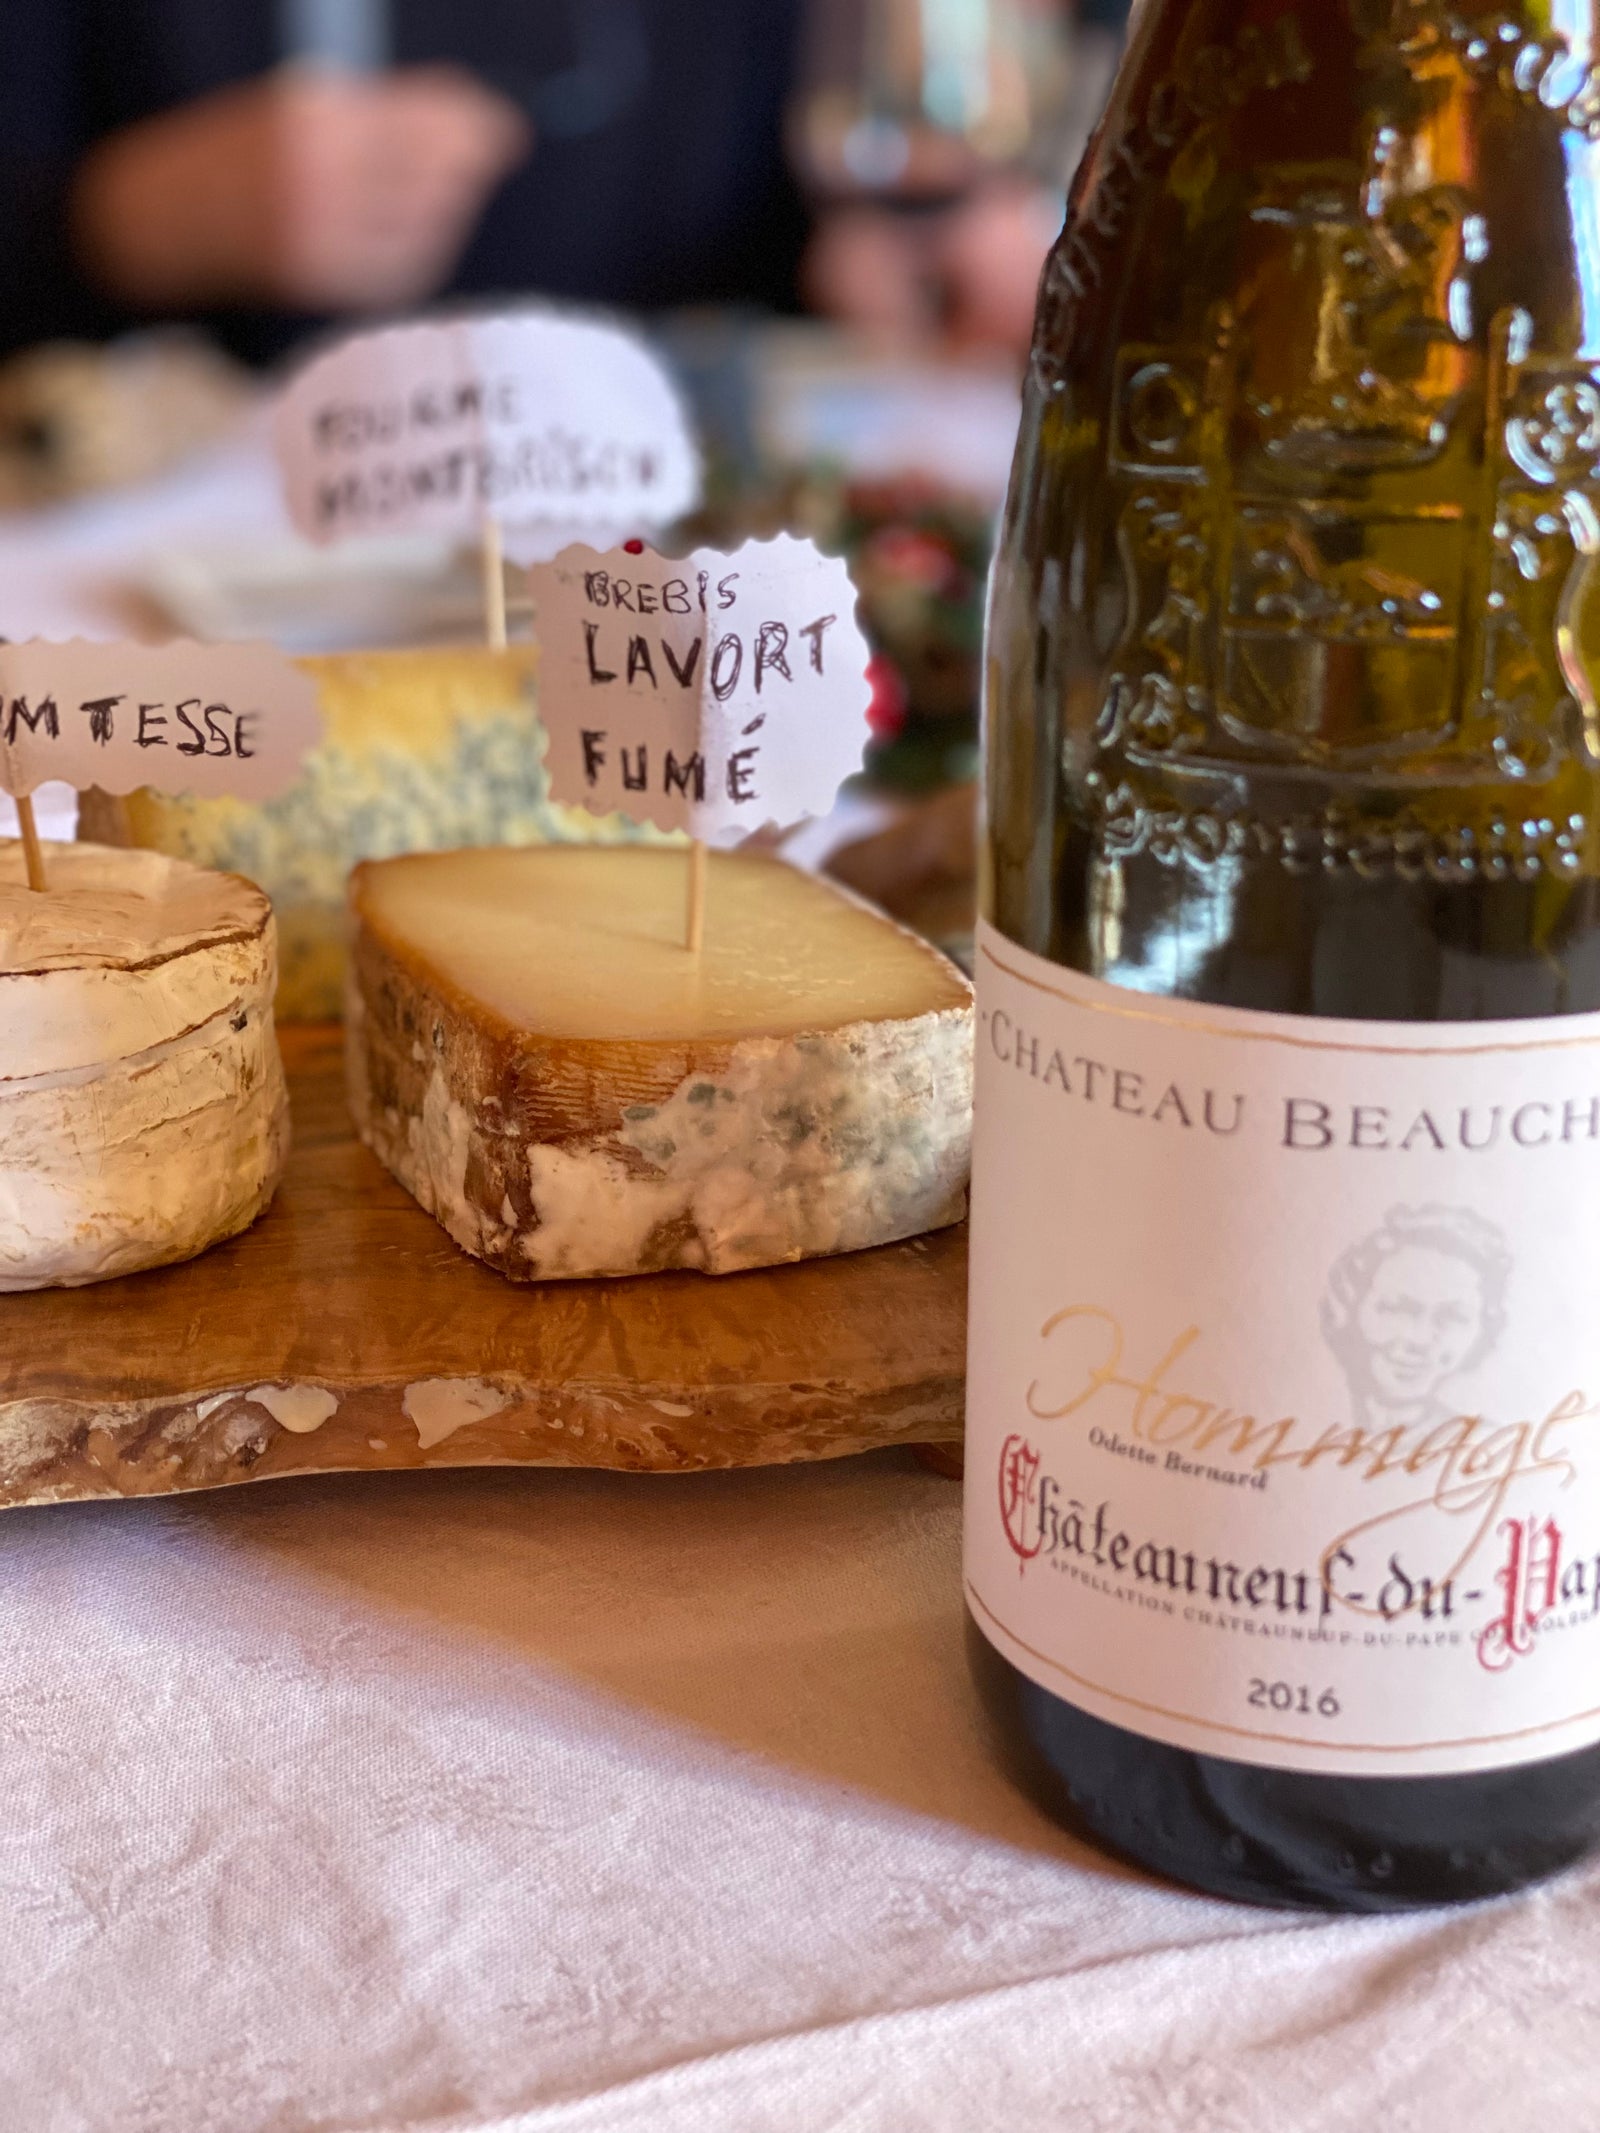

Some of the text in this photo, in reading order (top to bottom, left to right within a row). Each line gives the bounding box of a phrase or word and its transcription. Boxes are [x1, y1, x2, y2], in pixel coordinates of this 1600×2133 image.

[585, 570, 740, 614] BREBIS
[583, 614, 836, 701] LAVORT
[0, 695, 258, 758] MTESSE
[580, 713, 766, 804] FUMÉ
[990, 1008, 1246, 1136] CHATEAU
[1027, 1303, 1600, 1619] Hommage
[1089, 1426, 1269, 1491] Odette Bernard
[1247, 1677, 1341, 1717] 2016
